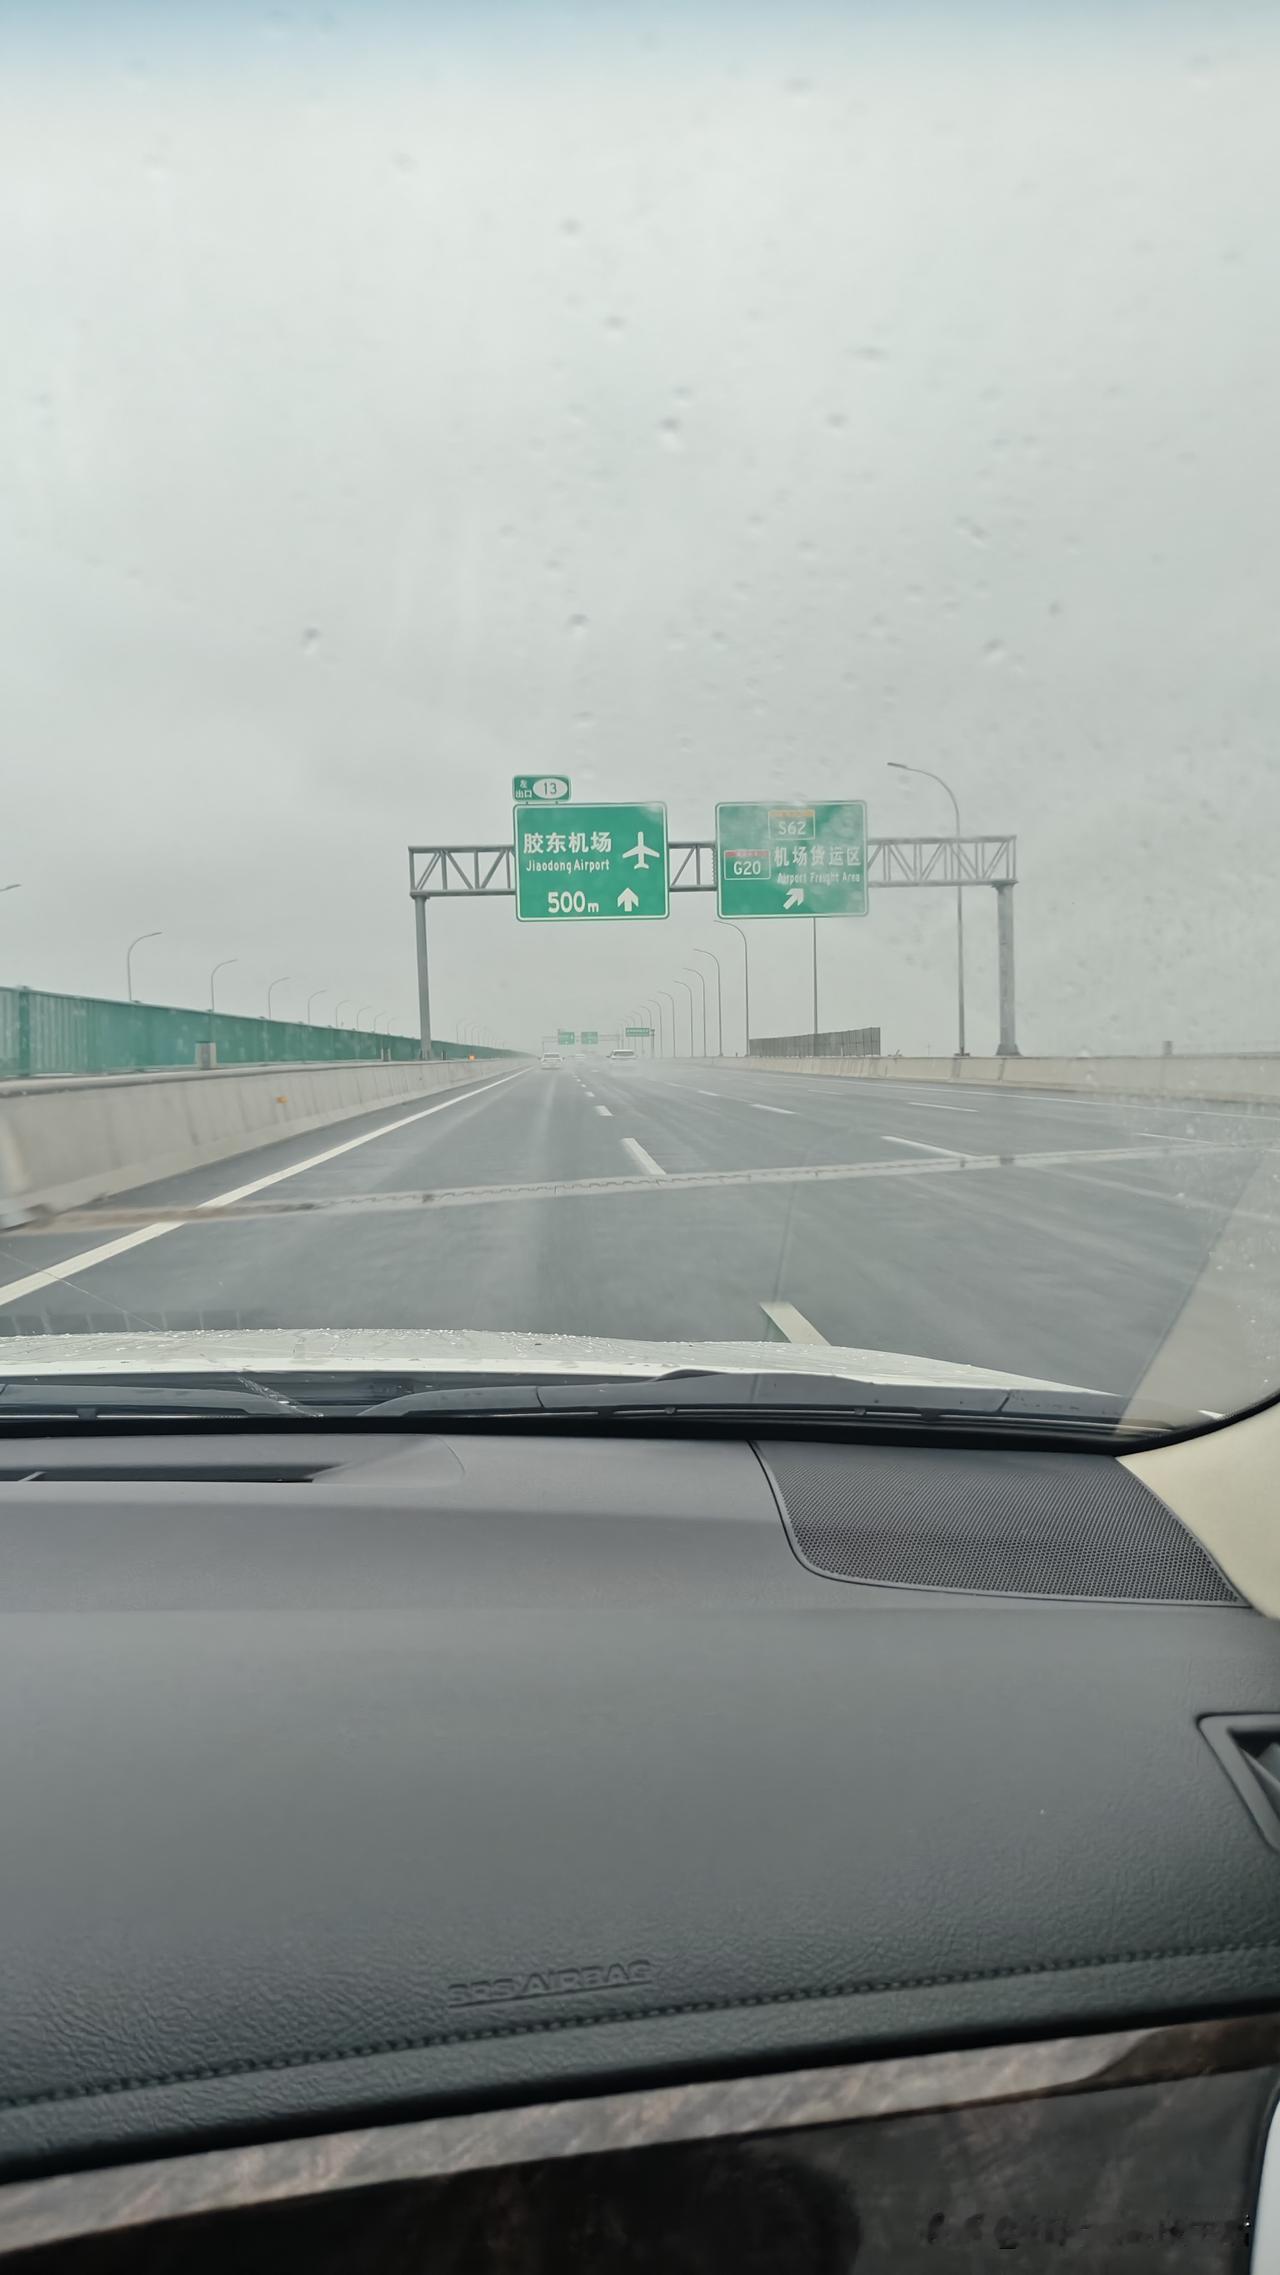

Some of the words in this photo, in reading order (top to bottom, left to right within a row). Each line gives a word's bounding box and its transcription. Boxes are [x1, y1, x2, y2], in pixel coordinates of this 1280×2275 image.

[543, 782, 558, 795] 13
[778, 821, 806, 836] S62
[523, 831, 612, 854] 胶东机场
[774, 846, 861, 867] 机场货运区
[526, 860, 572, 874] Jiaodong
[573, 859, 610, 873] Airport
[733, 860, 761, 875] G20
[777, 872, 806, 885] Airport
[810, 872, 839, 886] Freight
[842, 871, 861, 883] Area
[521, 1959, 653, 1996] AIRBAG
